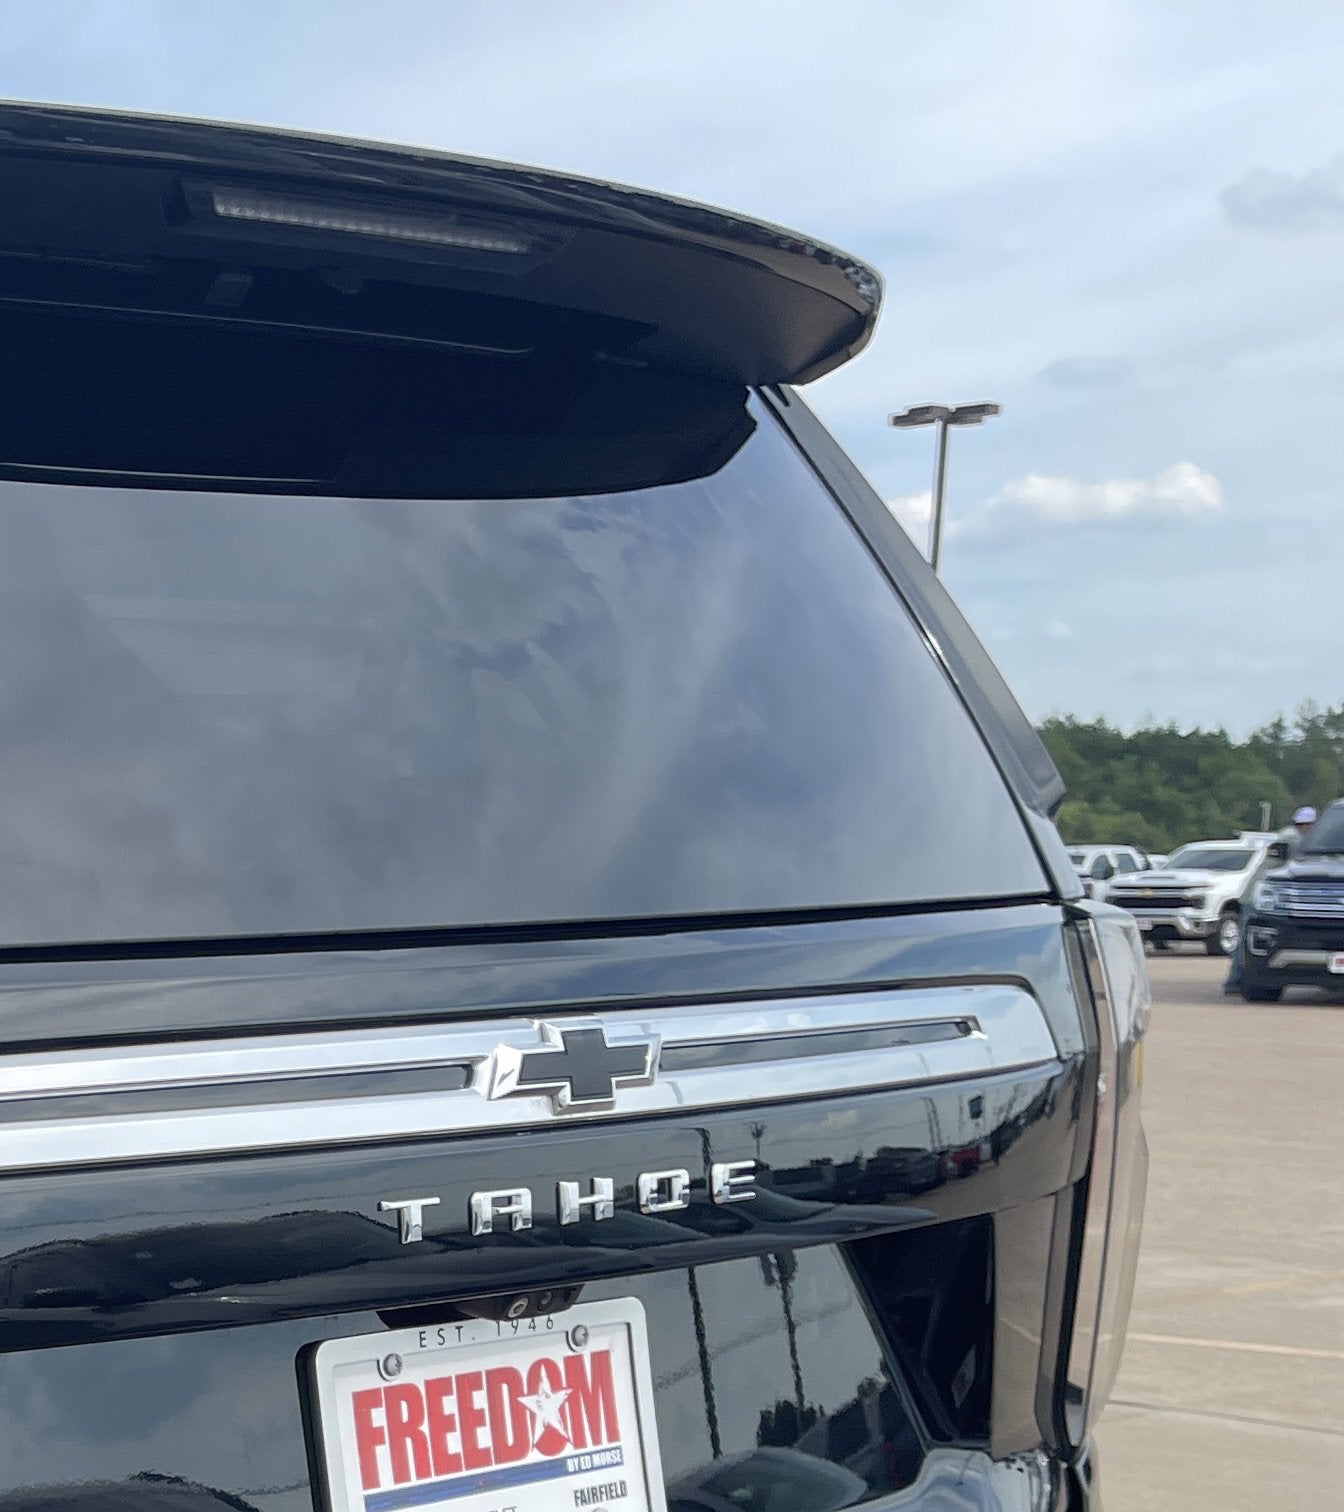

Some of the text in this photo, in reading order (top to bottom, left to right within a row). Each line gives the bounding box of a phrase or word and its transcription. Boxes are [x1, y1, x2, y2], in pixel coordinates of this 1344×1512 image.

[377, 1159, 758, 1245] TAHOE
[418, 1316, 554, 1348] EST. 1946
[352, 1349, 621, 1491] FREEDOM
[566, 1451, 623, 1473] BY ED MORSE
[573, 1479, 628, 1508] FAIRFIELD
